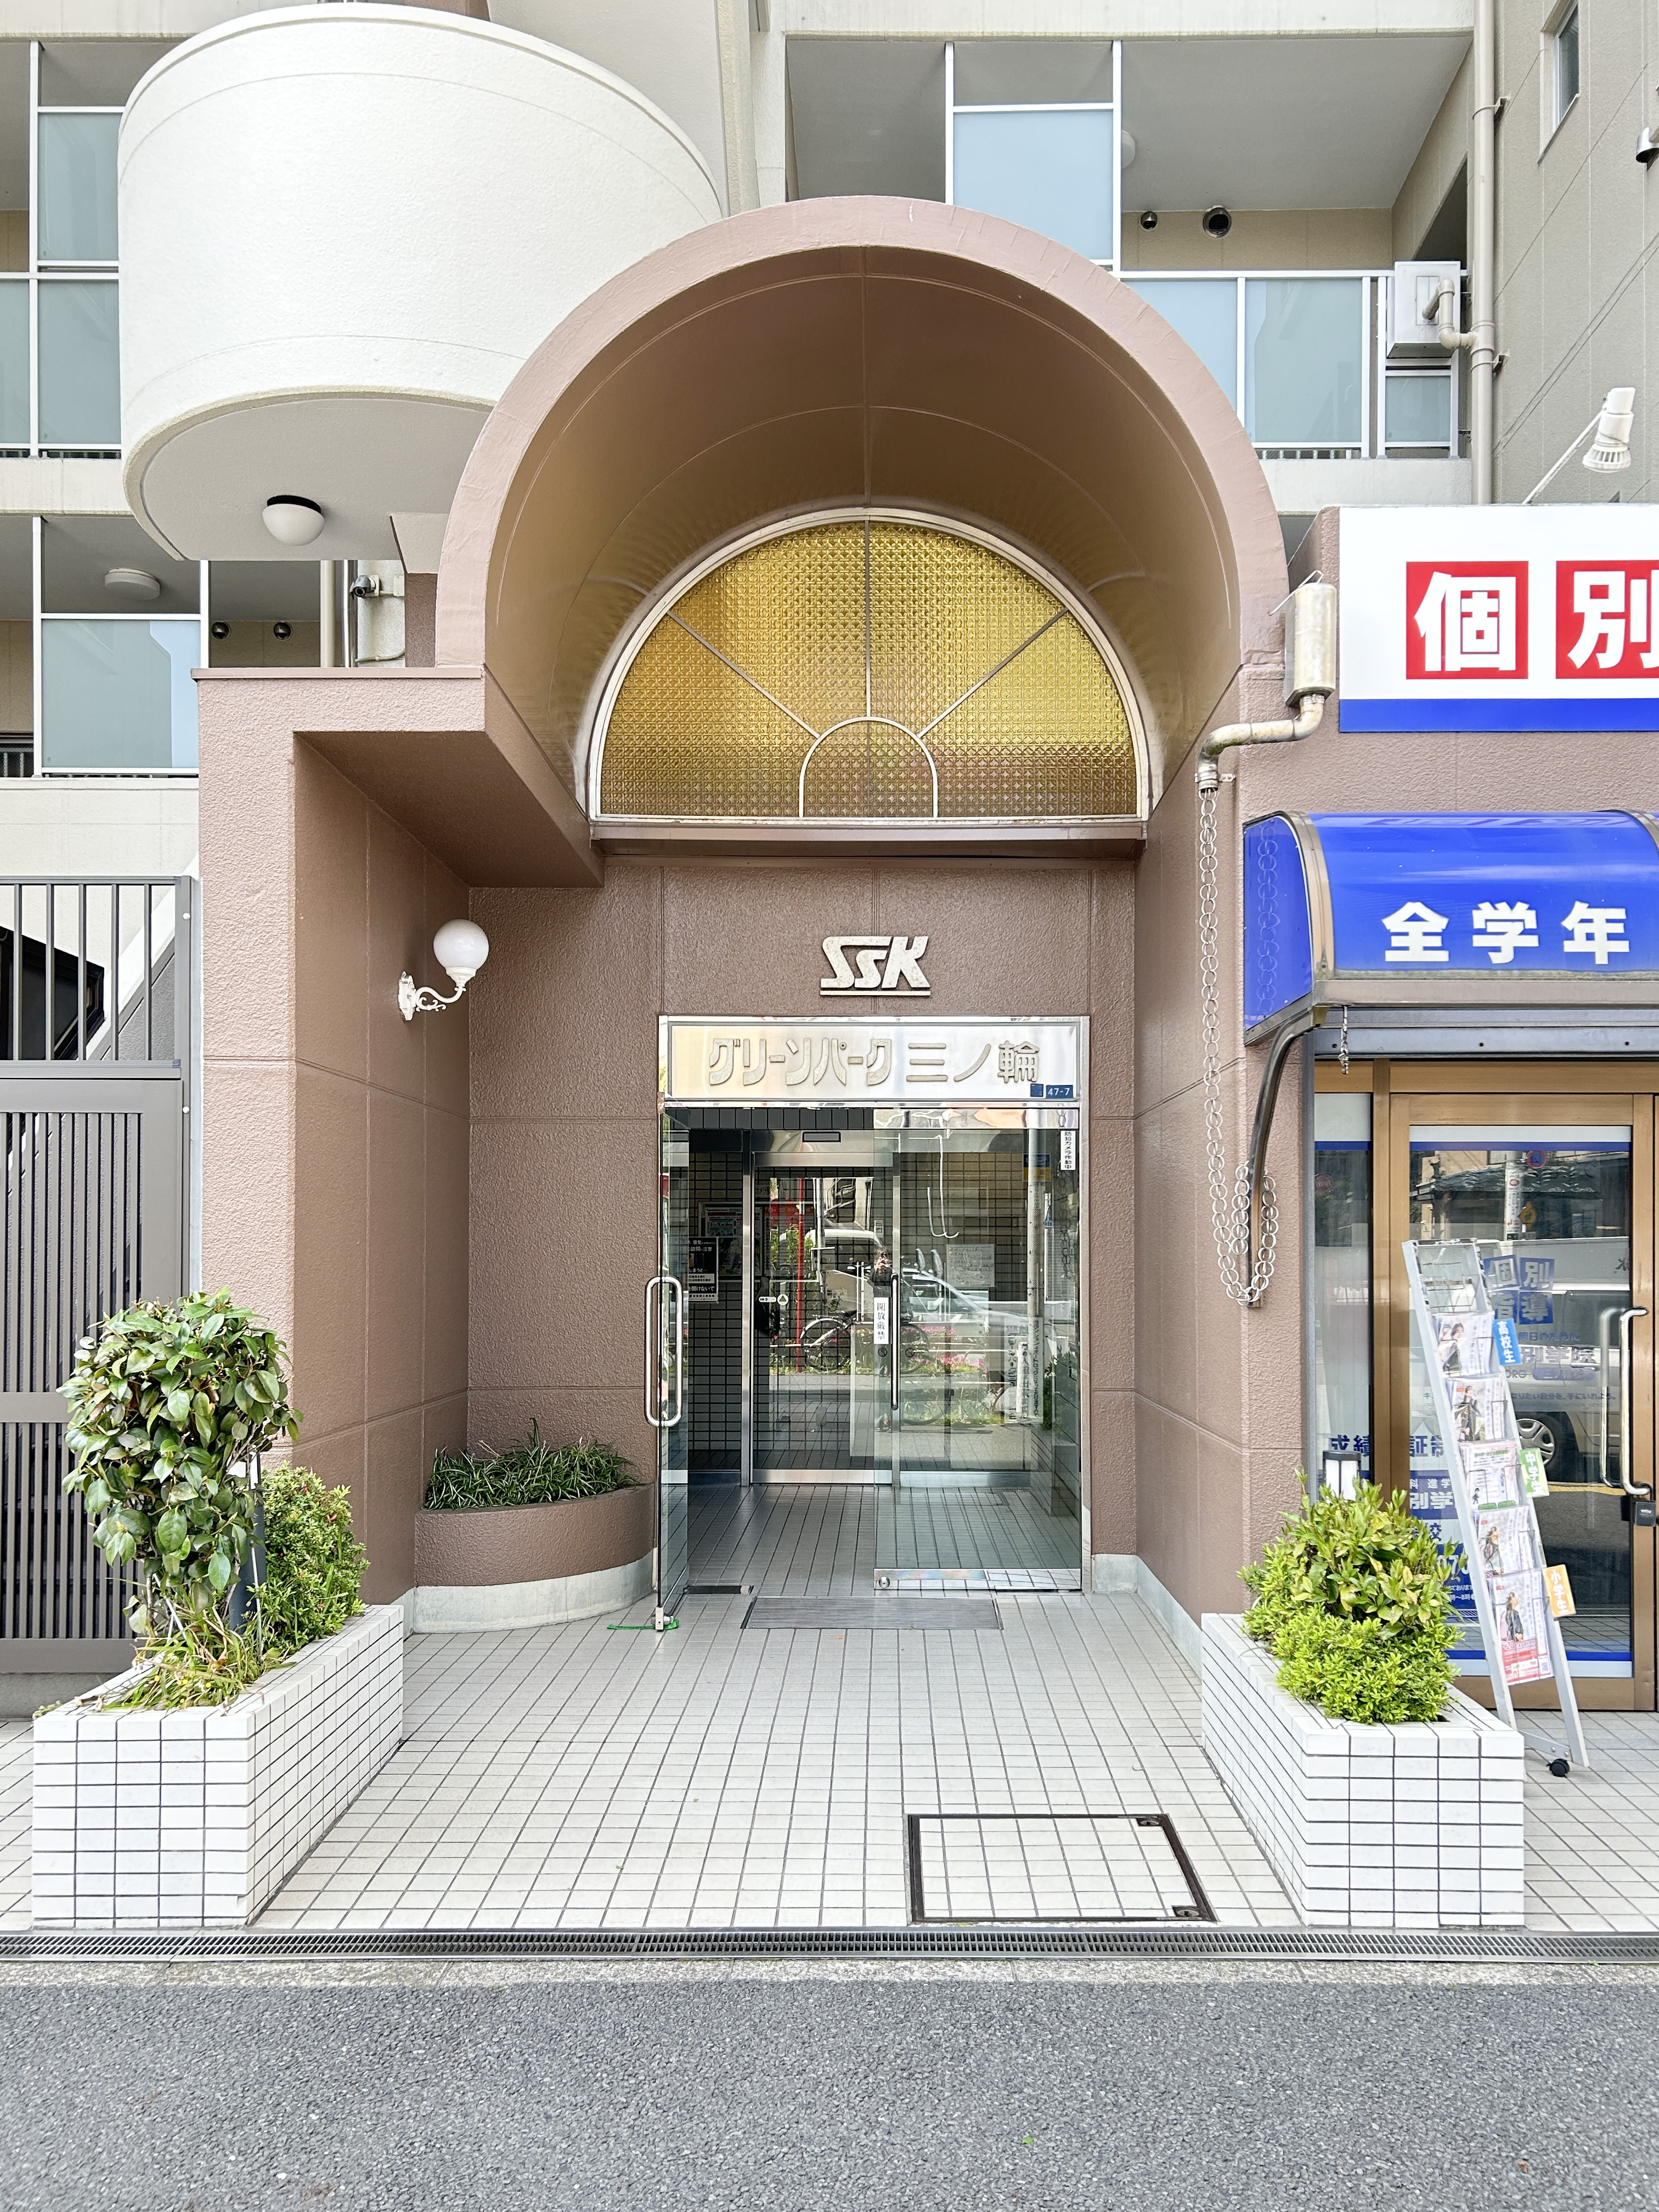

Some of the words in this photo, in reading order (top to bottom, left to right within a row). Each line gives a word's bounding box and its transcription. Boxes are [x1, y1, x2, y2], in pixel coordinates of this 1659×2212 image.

[1414, 571, 1658, 672] 個別
[1381, 901, 1630, 965] 全学年
[820, 935, 929, 989] SSK
[709, 1037, 1040, 1086] グリーンパーク三ノ輪
[1047, 1088, 1070, 1096] 47-7
[1486, 1258, 1550, 1289] 個別
[877, 1302, 886, 1340] 開放厳禁
[1497, 1321, 1516, 1364] 高校生
[1519, 1332, 1580, 1342] 明日のために
[1427, 1478, 1451, 1489] 進学
[1525, 1451, 1541, 1494] 中学生
[1550, 1569, 1569, 1614] 小学生
